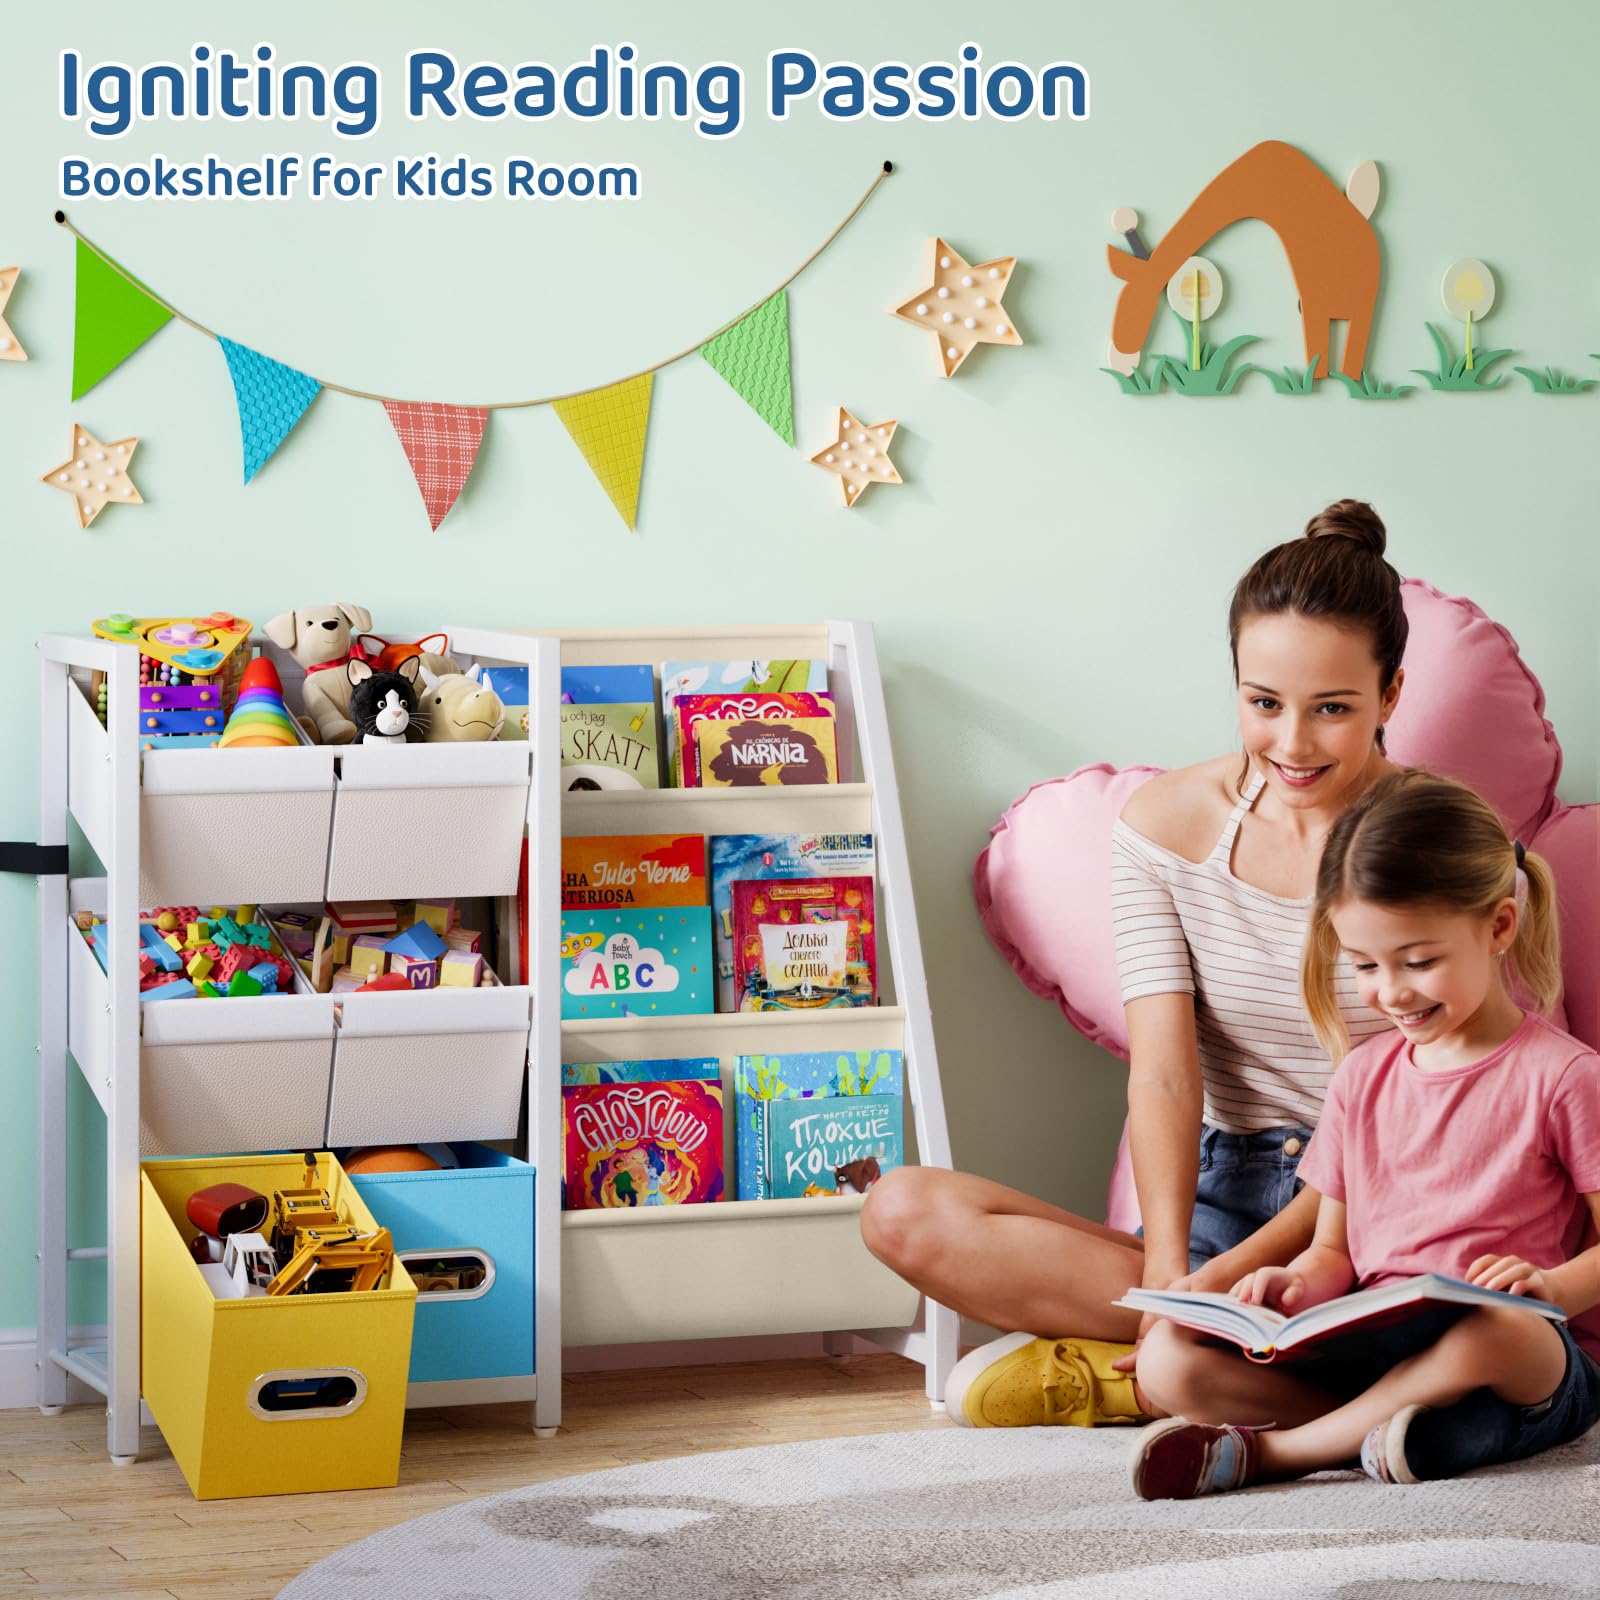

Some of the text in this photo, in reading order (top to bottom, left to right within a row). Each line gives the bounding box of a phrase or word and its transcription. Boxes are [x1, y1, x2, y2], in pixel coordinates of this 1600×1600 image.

[570, 710, 588, 721] och
[585, 711, 606, 727] jag
[572, 729, 651, 771] SKATT
[592, 859, 693, 887] Jules Verne
[561, 888, 636, 905] STERIOSA
[612, 943, 630, 954] Baby
[612, 951, 633, 960] Touch
[410, 966, 431, 987] M
[574, 1087, 708, 1154] GHOSTCLOUD
[785, 1141, 886, 1185] КОШК
